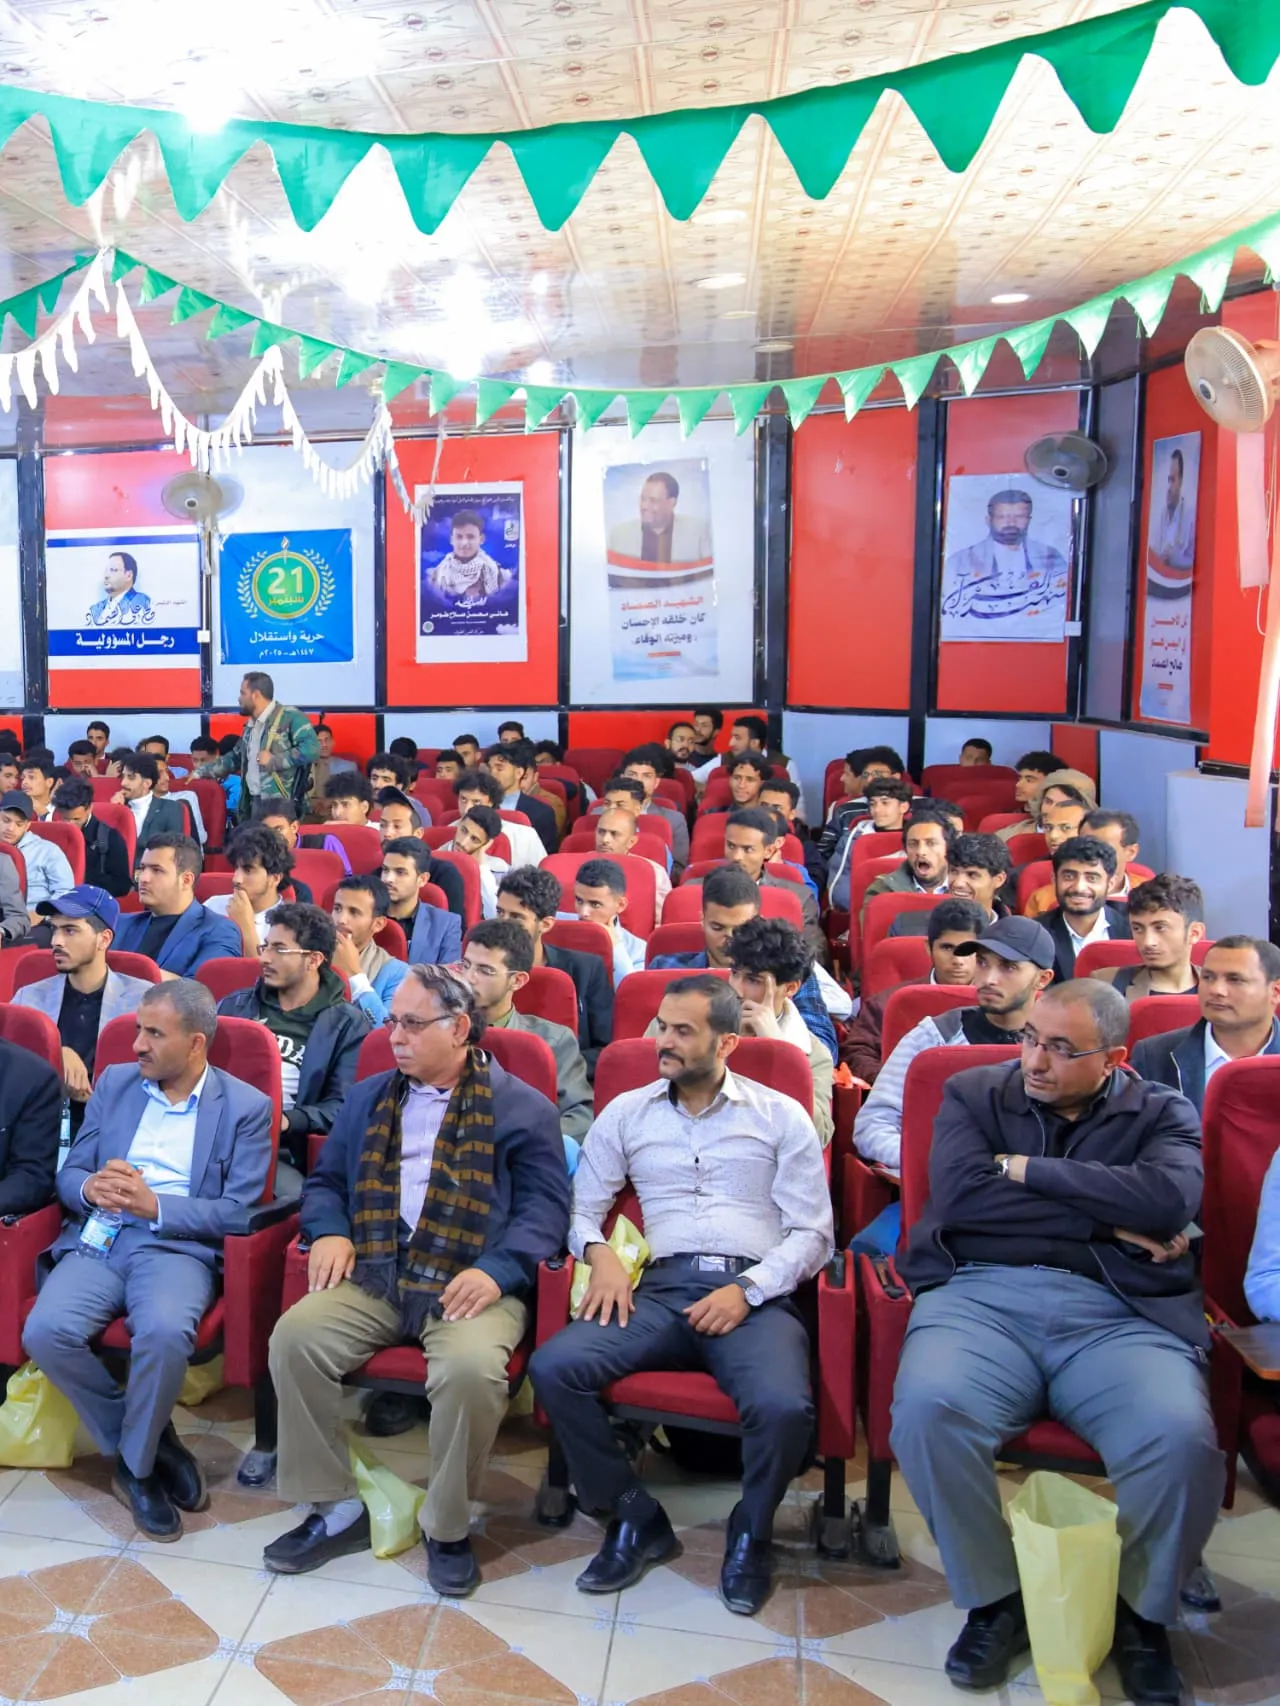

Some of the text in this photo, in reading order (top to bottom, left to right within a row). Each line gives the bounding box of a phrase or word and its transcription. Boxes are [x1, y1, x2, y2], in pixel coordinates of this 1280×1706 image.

[267, 566, 303, 595] 21
[268, 595, 305, 607] سبتمبر
[662, 613, 687, 625] خلقه
[689, 612, 706, 625] كان
[75, 631, 135, 650] المسؤولية
[249, 630, 325, 644] حرية واستقلال
